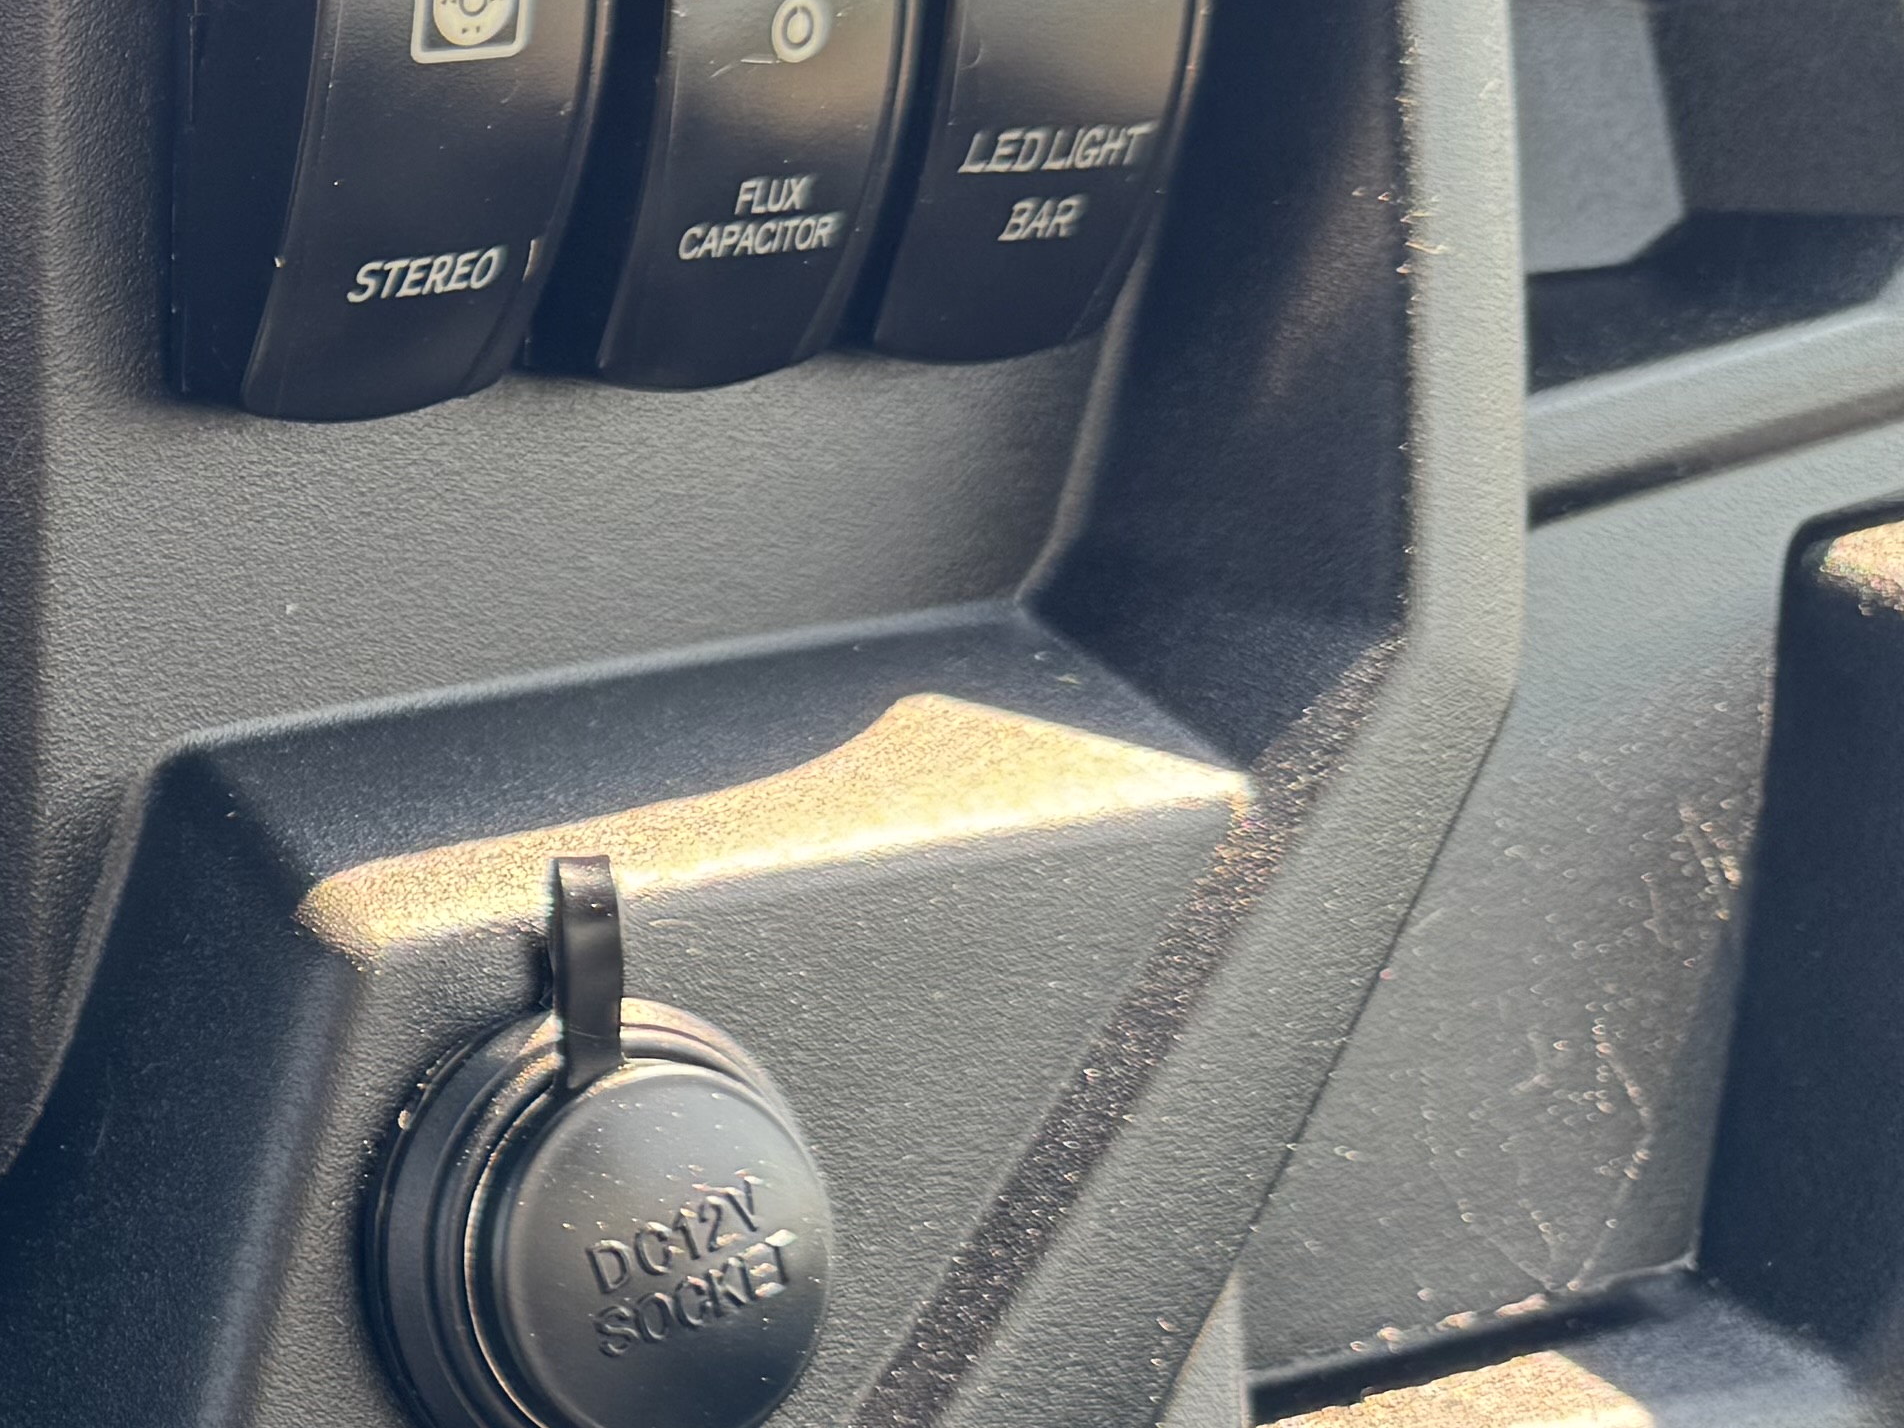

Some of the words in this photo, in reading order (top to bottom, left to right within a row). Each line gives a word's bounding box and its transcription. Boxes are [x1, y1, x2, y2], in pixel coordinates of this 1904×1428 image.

[957, 126, 1049, 173] LED
[1041, 121, 1159, 171] LIGHT
[735, 175, 816, 216] FLUX
[997, 194, 1087, 241] BAR
[679, 211, 845, 261] CAPACITOR
[347, 246, 506, 303] STEREO
[594, 1229, 797, 1358] SOCKET
